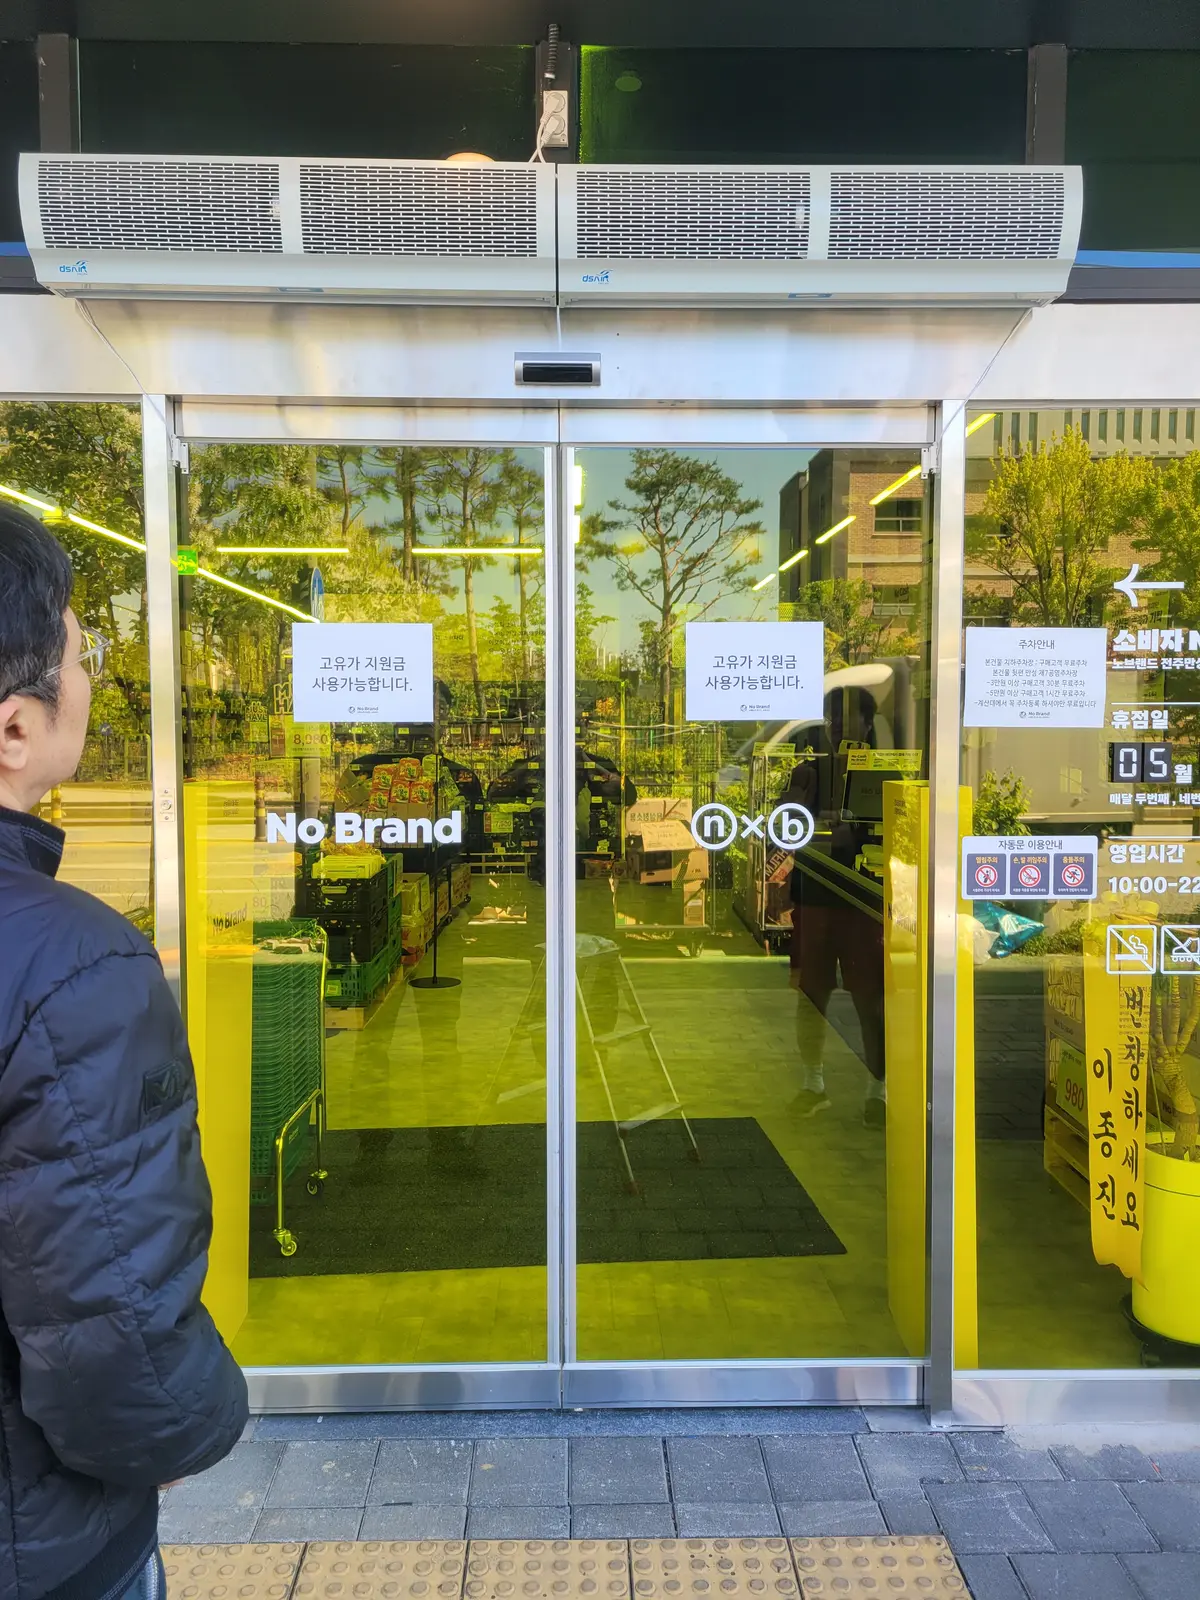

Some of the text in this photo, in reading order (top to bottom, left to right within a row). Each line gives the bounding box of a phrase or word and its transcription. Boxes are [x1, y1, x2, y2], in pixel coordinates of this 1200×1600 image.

[1018, 639, 1055, 650] 주차안내
[1113, 628, 1184, 652] 소비자
[320, 656, 406, 671] 고유가 지원금
[713, 655, 797, 670] 고유가 지원금
[1040, 659, 1063, 667] 구매고객
[1064, 659, 1088, 667] 무료주차
[1112, 657, 1159, 669] 노브랜드
[312, 677, 413, 692] 사용가능합니다.
[705, 675, 804, 691] 사용가능합니다.
[1007, 679, 1019, 688] 이상
[1021, 680, 1045, 688] 구매고객
[1061, 680, 1085, 688] 무료주차
[1006, 689, 1019, 697] 이상
[1020, 690, 1044, 698] 구매고객
[1045, 690, 1060, 698] 1시간
[1061, 690, 1086, 698] 무료주차
[1111, 710, 1169, 730] 휴점일
[1119, 747, 1193, 784] 05 월
[1109, 792, 1133, 805] 매달
[267, 810, 462, 844] No Brand
[998, 839, 1063, 850] 자동문 이용안내
[1109, 844, 1186, 864] 영업시간
[1065, 1078, 1085, 1112] 980
[1121, 985, 1146, 1232] 번창하세요
[1092, 1047, 1118, 1221] 이종진
